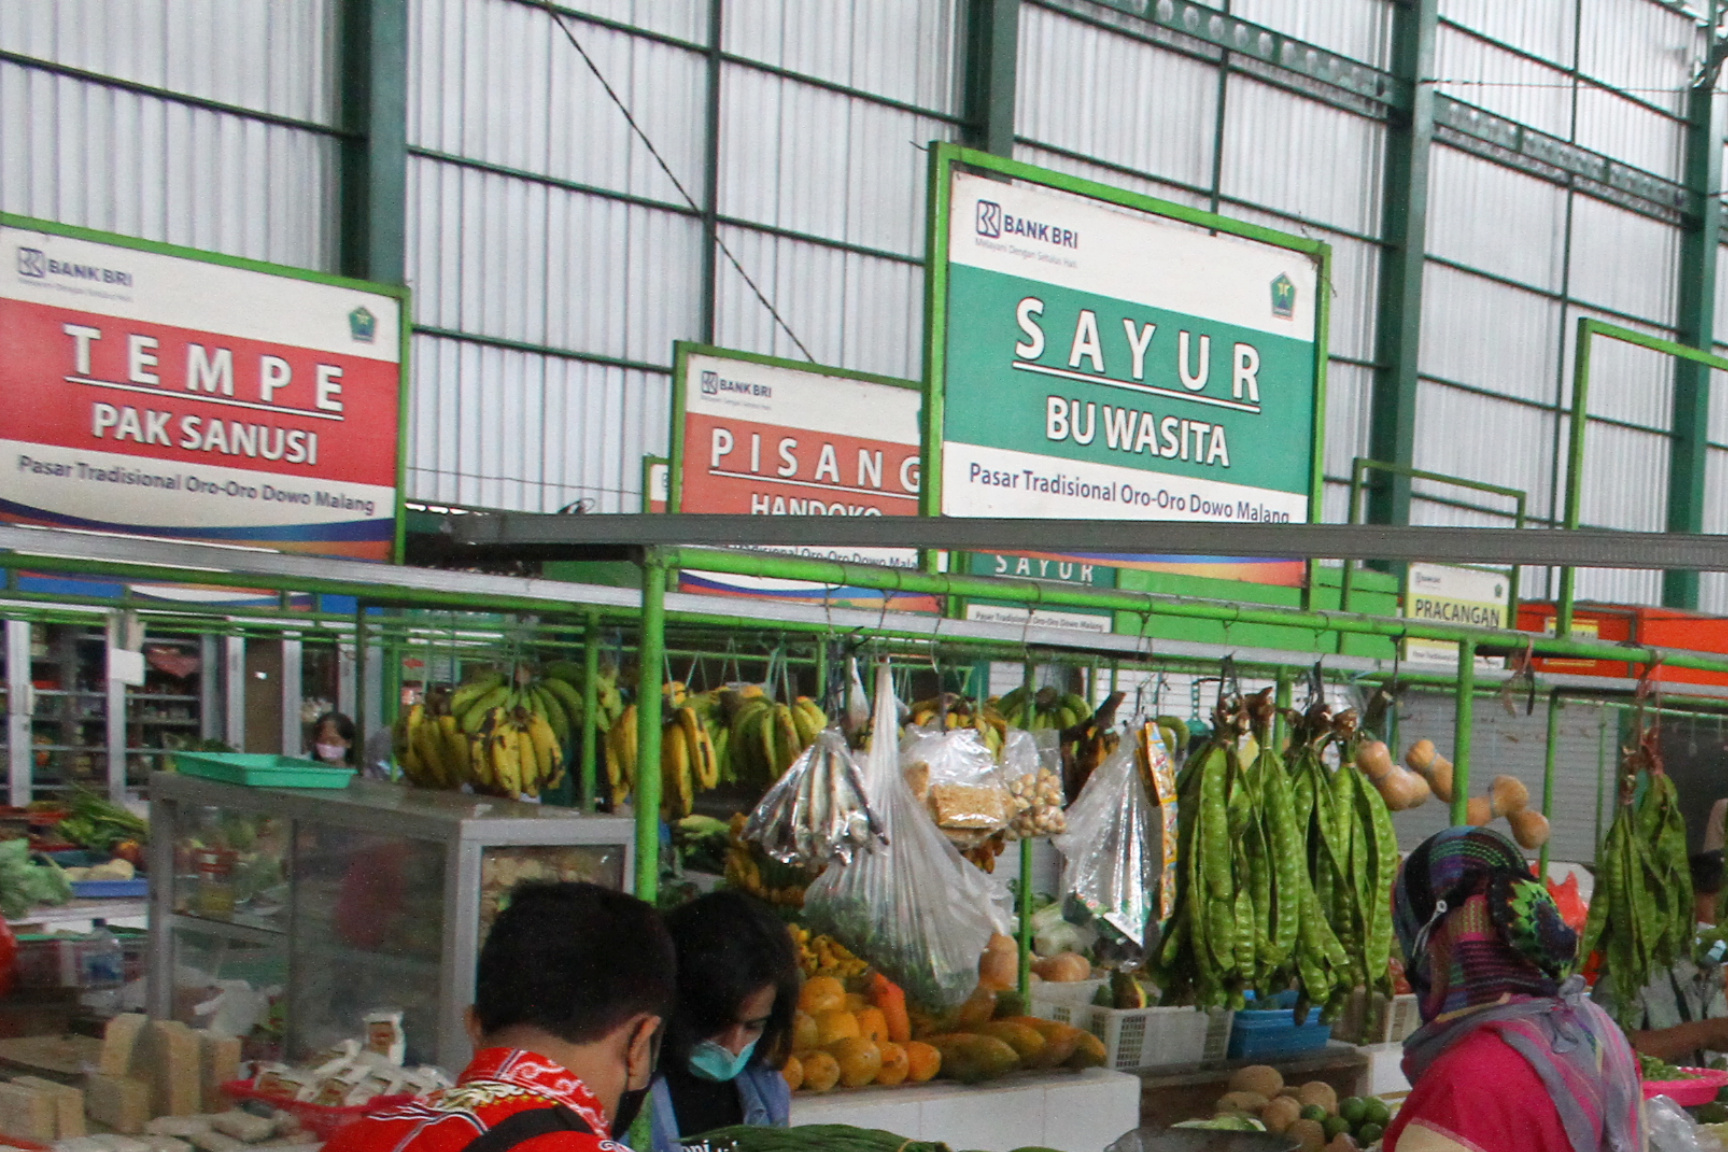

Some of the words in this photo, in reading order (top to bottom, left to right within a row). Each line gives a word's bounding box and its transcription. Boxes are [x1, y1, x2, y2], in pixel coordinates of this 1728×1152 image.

[1003, 214, 1050, 243] BANK
[1051, 226, 1079, 250] BRI
[47, 258, 101, 283] BANK
[101, 267, 134, 288] BRI
[62, 322, 345, 412] TEMPE
[1014, 296, 1261, 403] SAYUR
[719, 378, 751, 396] BANK
[752, 385, 772, 398] BRI
[91, 402, 173, 447] PAK
[180, 414, 319, 466] SANUSI
[710, 426, 920, 493] PISANG
[1045, 395, 1097, 446] BU
[1101, 404, 1231, 468] WASITA
[18, 454, 74, 479] Pasar
[76, 461, 182, 492] Tradisional
[186, 475, 257, 500] Oro-Oro
[262, 484, 312, 506] Dowo
[315, 490, 376, 517] Malang
[969, 461, 1020, 490] Pasar
[1023, 469, 1117, 502] Tradisional
[1120, 483, 1187, 512] Oro-Oro
[1189, 493, 1234, 519] Dowo
[1236, 500, 1290, 525] Malang
[1415, 598, 1501, 628] PRACANGAN
